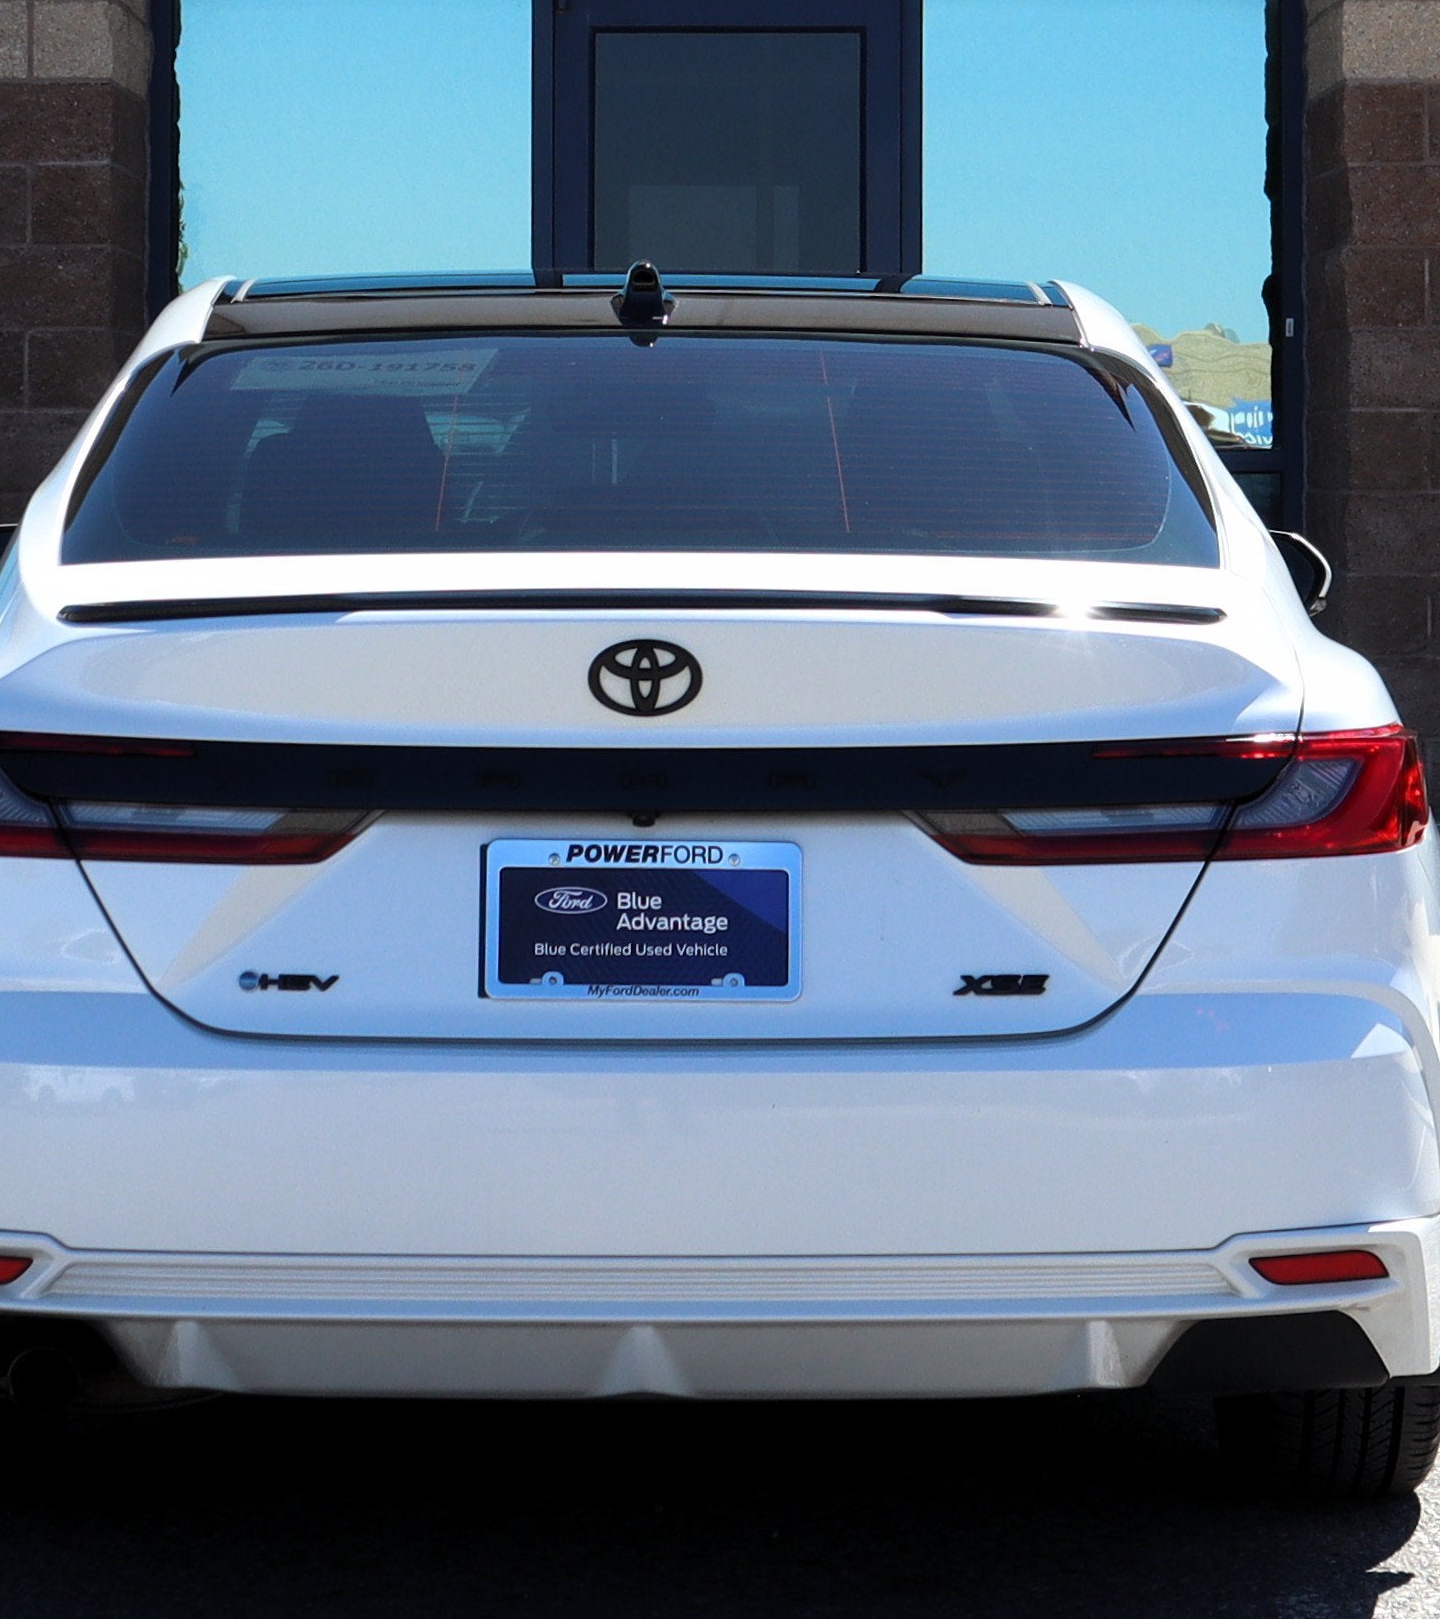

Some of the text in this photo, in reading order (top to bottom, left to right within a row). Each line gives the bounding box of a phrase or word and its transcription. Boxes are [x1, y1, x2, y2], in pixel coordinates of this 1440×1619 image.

[565, 844, 724, 865] POWERFORD
[548, 891, 593, 910] Ford
[617, 892, 662, 910] Blue
[616, 913, 729, 934] Advantage
[534, 942, 728, 957] Blue Certified Used Vehicle
[587, 984, 700, 998] MyFordDealer.com
[952, 974, 1050, 996] XSE
